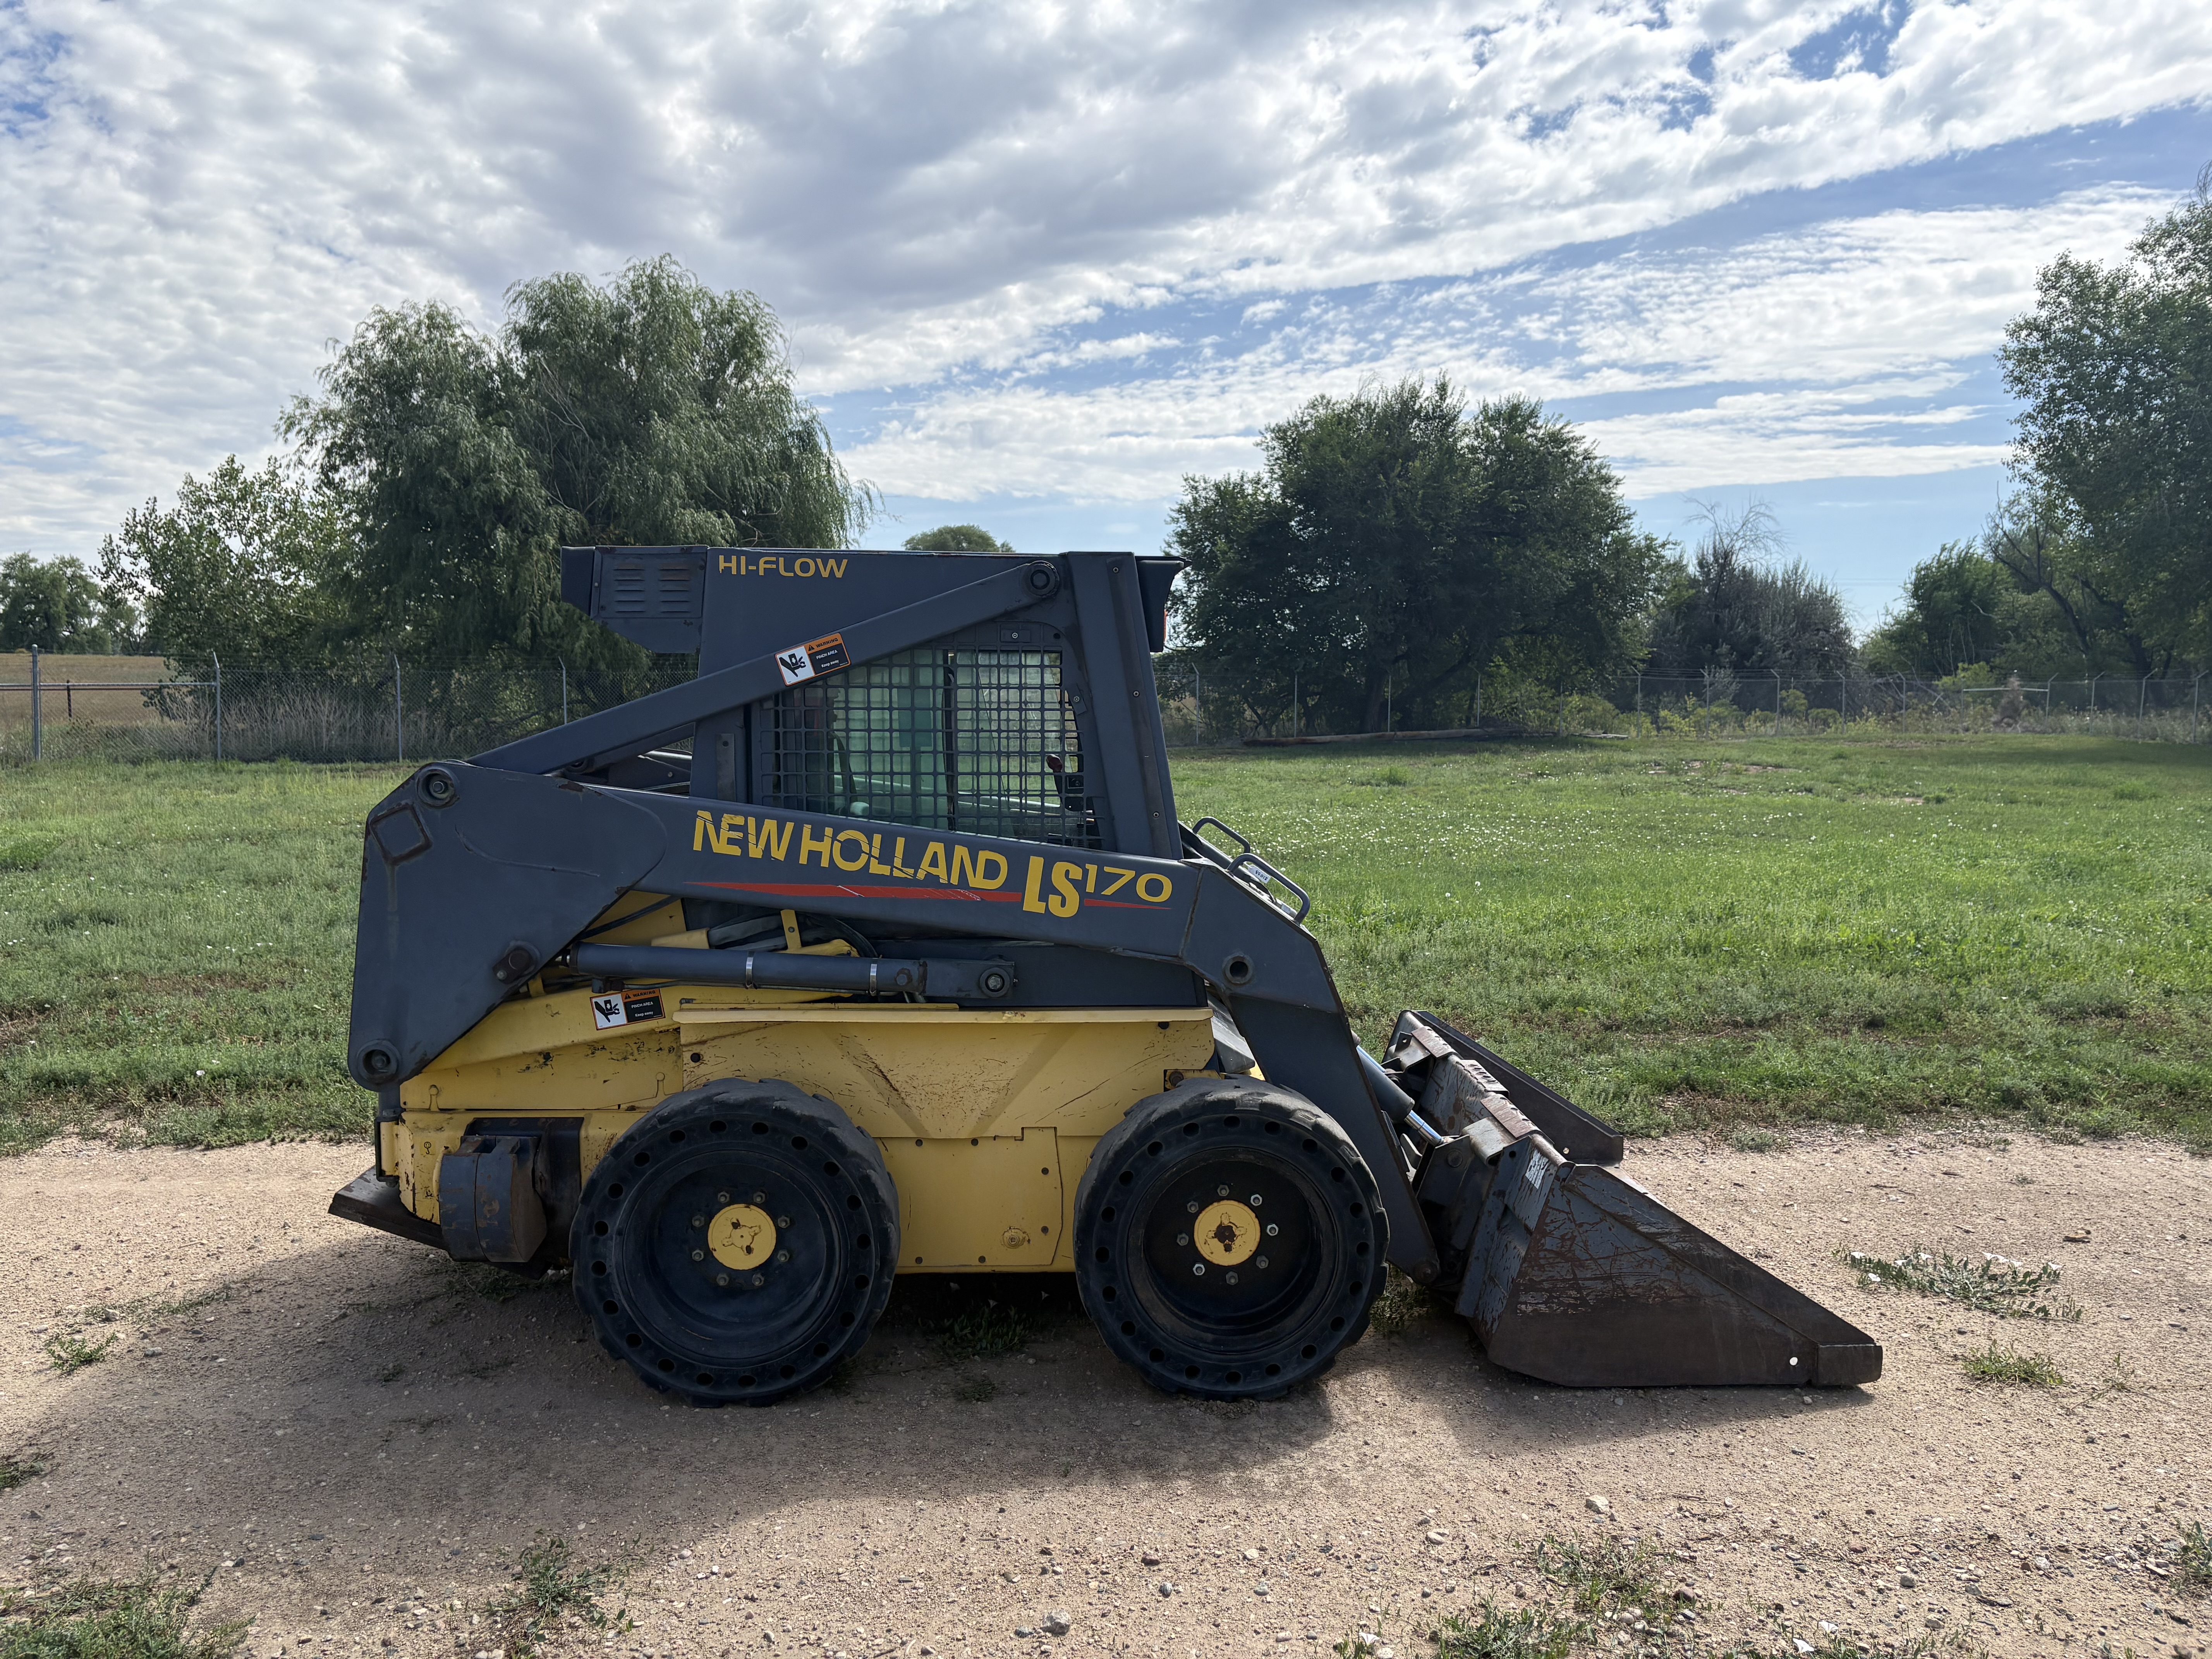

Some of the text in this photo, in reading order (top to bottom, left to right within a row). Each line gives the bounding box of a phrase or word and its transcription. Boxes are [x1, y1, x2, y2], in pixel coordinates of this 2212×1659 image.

[719, 555, 848, 578] HI-FLOW
[816, 638, 838, 648] WARNING
[693, 811, 794, 860] NEW
[799, 825, 1008, 890] HOLLAND
[1255, 870, 1268, 881] 21033
